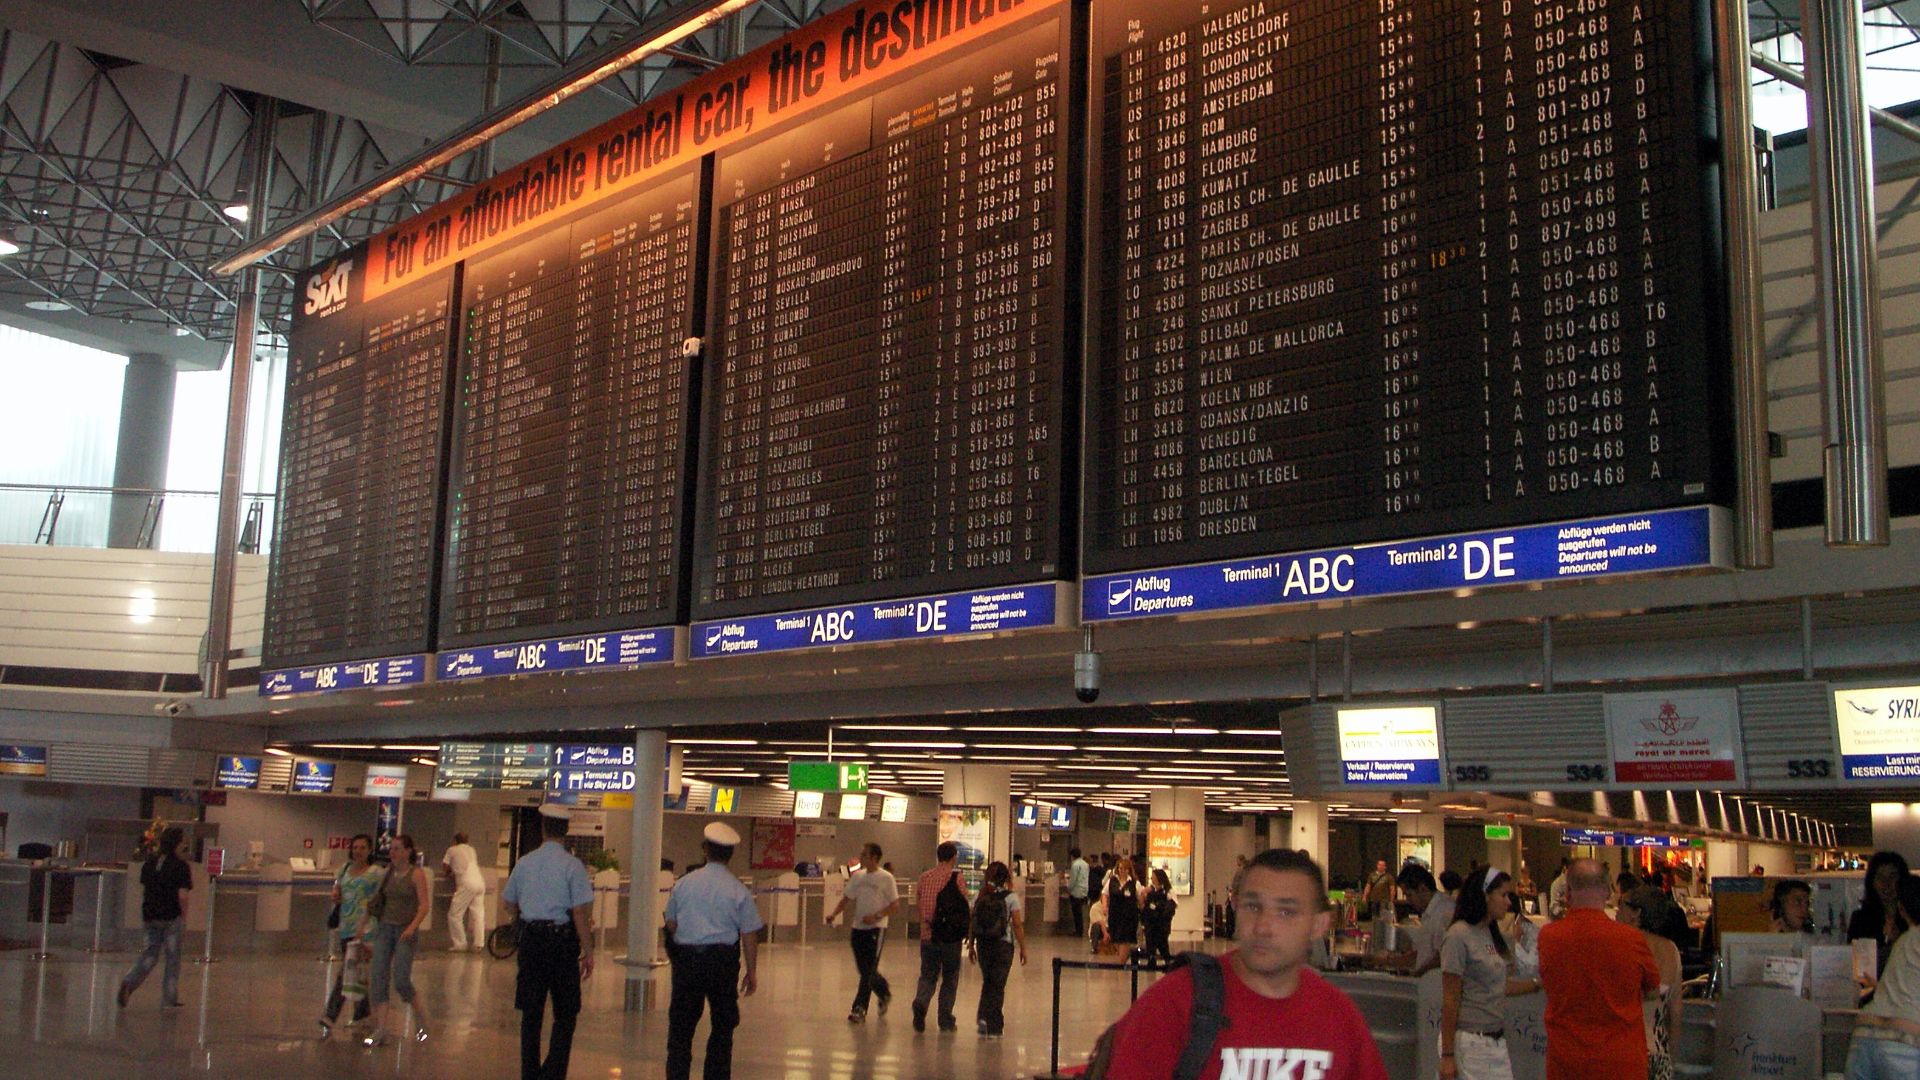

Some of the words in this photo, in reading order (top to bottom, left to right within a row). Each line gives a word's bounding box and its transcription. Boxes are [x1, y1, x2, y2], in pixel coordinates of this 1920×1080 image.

[1202, 1, 1265, 37] VALENCIA
[1158, 31, 1187, 53] 4520
[1202, 12, 1289, 57] DUESSELDORF
[1535, 16, 1608, 51] 050-468
[1165, 51, 1186, 71] 808
[1202, 33, 1289, 77] LONDON-CITY
[1157, 71, 1186, 93] 4808
[1202, 59, 1273, 97] INNSBRUCK
[1036, 83, 1056, 102] B55
[1202, 80, 1273, 116] AMSTERDAM
[980, 95, 1023, 123] 701-702
[1036, 104, 1049, 120] E3
[1537, 87, 1612, 123] 801-807
[979, 113, 1022, 141] 808-809
[1035, 120, 1055, 138] B48
[1202, 116, 1225, 138] ROM
[979, 131, 1022, 158] 481-489
[1202, 127, 1257, 158] HAMBURG
[384, 231, 418, 284] For
[422, 213, 451, 266] an
[457, 147, 586, 251] affordable
[593, 94, 684, 191] rental
[693, 72, 754, 146] car,
[768, 39, 827, 114] the
[1202, 149, 1257, 178] FLORENZ
[780, 175, 815, 199] BELGRAD
[1201, 171, 1249, 198] KUWAIT
[1250, 187, 1272, 205] CH.
[1283, 177, 1298, 195] DE
[1308, 160, 1360, 188] GAULLE
[780, 196, 804, 215] MINSK
[779, 208, 814, 231] BANGKOK
[1201, 213, 1249, 240] ZAGREB
[1541, 210, 1616, 243] 897-899
[778, 223, 818, 247] CHISINAU
[1201, 238, 1240, 260] PARIS
[1250, 230, 1272, 247] CH.
[1283, 221, 1298, 238] DE
[1308, 204, 1360, 231] GAULLE
[1201, 243, 1300, 280] POZNAN/POSEN
[1201, 274, 1264, 302] BRUESSEL
[1201, 301, 1239, 323] SANKT
[1250, 277, 1335, 312] PETERSBURG
[775, 290, 810, 312] SEVILLA
[1645, 301, 1666, 321] T6
[774, 307, 809, 328] COLOMBO
[1201, 320, 1248, 344] BILBAO
[1201, 343, 1240, 365] PALMA
[1250, 338, 1265, 355] DE
[1274, 320, 1344, 349] MALLORCA
[1201, 367, 1232, 387] WIEN
[1201, 387, 1240, 408] KOELN
[1250, 380, 1273, 398] HBF
[1200, 395, 1308, 429] GDANSK/DANZIG
[1200, 427, 1256, 450] VENEDIG
[1200, 446, 1273, 473] BARCELONA
[1200, 464, 1299, 494] BERLIN-TEGEL
[1549, 466, 1625, 493] 050-468
[1200, 515, 1256, 537] DRESDEN
[1558, 527, 1592, 540] Abflüge
[1593, 523, 1627, 535] werden
[1628, 519, 1651, 531] nicht
[1558, 537, 1606, 552] ausgerufen
[1559, 549, 1608, 564] Departures
[1609, 545, 1626, 557] will
[1627, 545, 1643, 555] not
[1644, 543, 1657, 554] be
[1223, 566, 1272, 583] Terminal
[1274, 563, 1281, 577] 1
[1283, 554, 1355, 597] ABC
[1388, 547, 1446, 566] Terminal
[1448, 543, 1458, 560] 2
[1463, 536, 1516, 580] DE
[1559, 560, 1608, 575] announced
[1134, 576, 1171, 592] Abflug
[1134, 593, 1194, 612] Departures
[722, 625, 745, 637] Abflug
[775, 618, 805, 631] Terminal
[806, 615, 811, 627] 1
[811, 610, 854, 643] ABC
[873, 607, 907, 620] Terminal
[908, 603, 914, 616] 2
[916, 600, 948, 633] DE
[516, 643, 546, 669] ABC
[585, 637, 606, 663] DE
[721, 639, 758, 652] Departures
[315, 667, 338, 688] ABC
[363, 662, 380, 684] DE
[1888, 698, 1920, 719] SYRI
[585, 756, 621, 765] Departures
[586, 747, 609, 756] Abflug
[622, 746, 634, 765] B
[1886, 755, 1905, 765] Last
[584, 770, 612, 779] Terminal
[613, 771, 619, 780] 2
[1346, 762, 1370, 771] Verkauf
[1374, 761, 1415, 772] Reservierung
[1347, 772, 1364, 781] Sales
[1368, 771, 1408, 780] Reservations
[1566, 764, 1604, 782] 534
[1788, 759, 1830, 778] 533
[621, 771, 636, 790] D
[1220, 1047, 1334, 1080] NIKE
